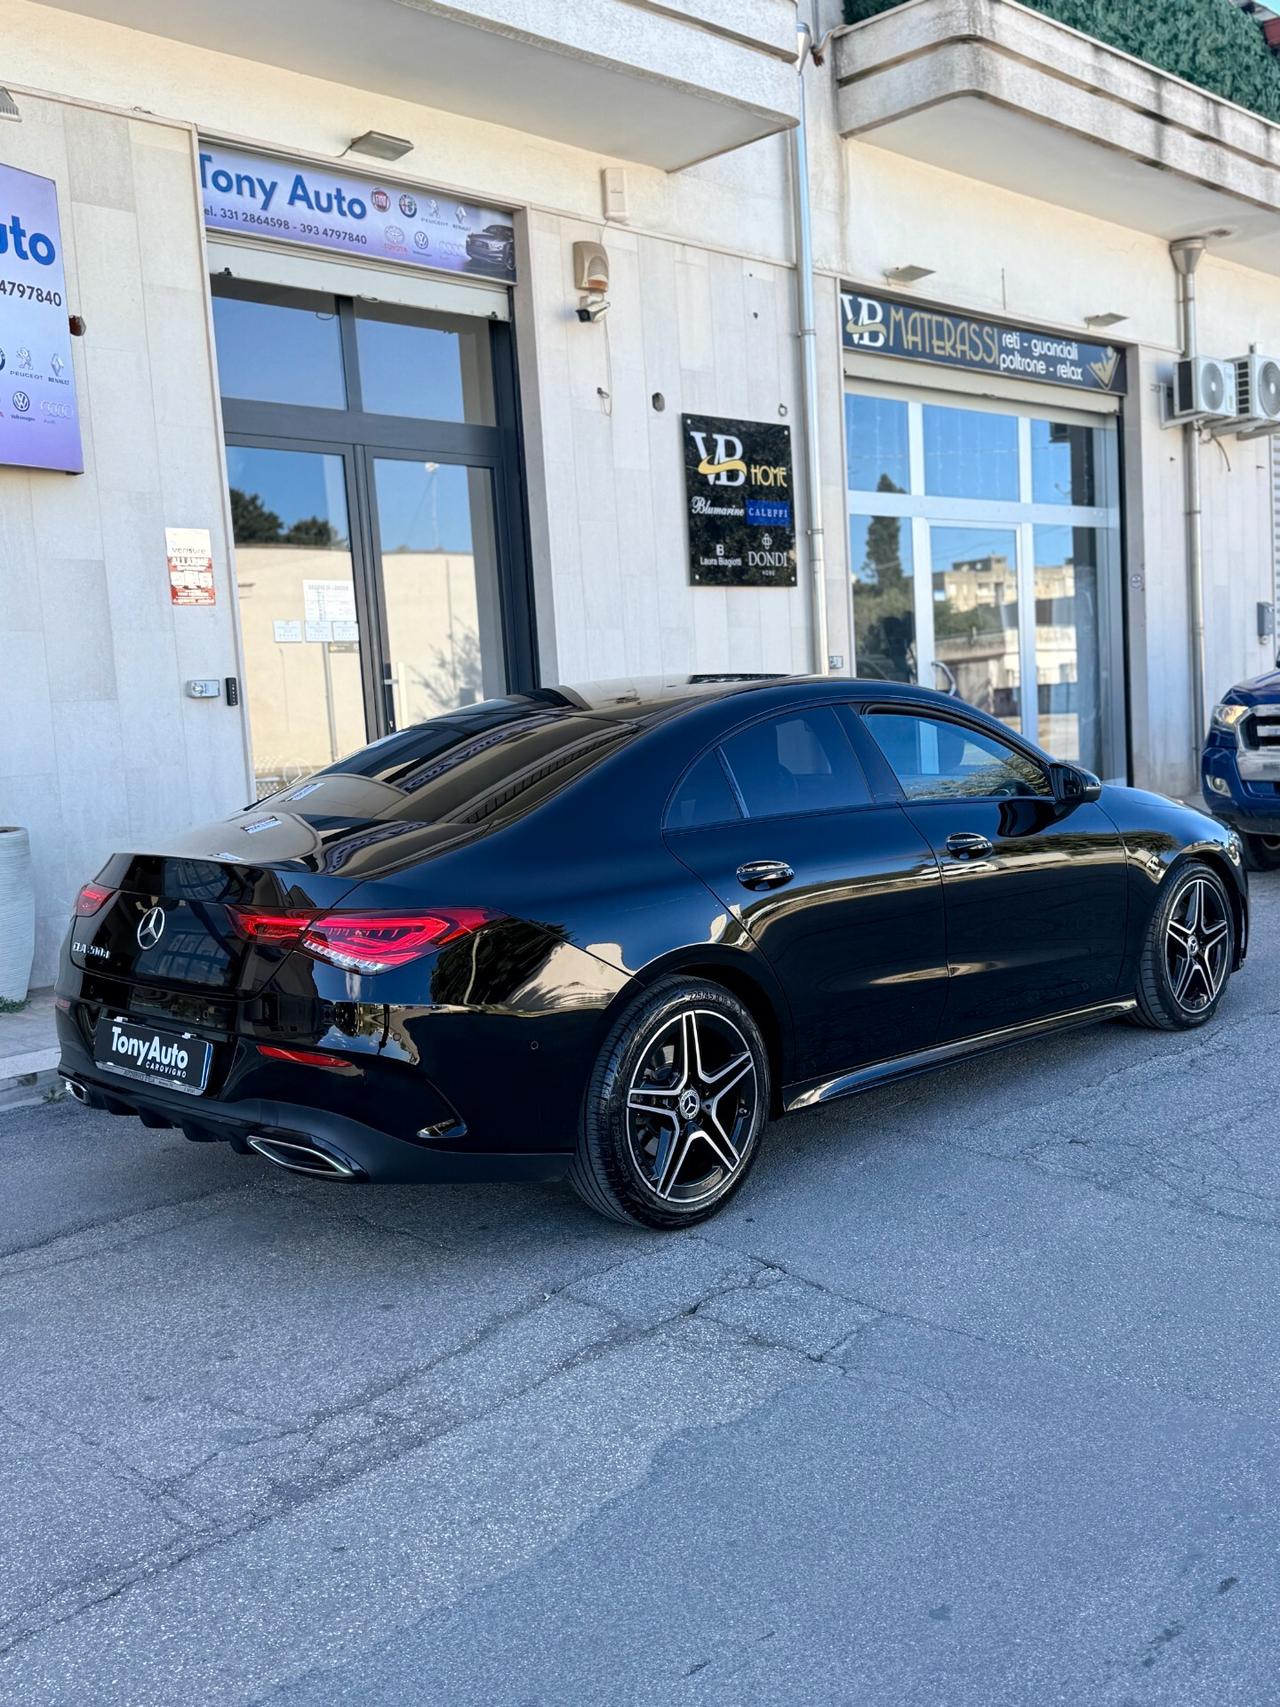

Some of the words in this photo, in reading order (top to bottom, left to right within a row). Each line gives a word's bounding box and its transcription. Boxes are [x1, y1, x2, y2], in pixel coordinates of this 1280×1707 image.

[199, 153, 277, 210] Tony
[287, 174, 367, 220] Auto
[220, 208, 238, 221] 331
[242, 212, 290, 230] 2864598
[300, 223, 320, 236] 393
[322, 227, 367, 245] 4797840
[0, 279, 62, 307] 4797840
[889, 306, 999, 365] MATERASSI
[1002, 332, 1020, 349] reti
[1031, 339, 1079, 360] guanciali
[1000, 351, 1047, 374] poltrone
[1057, 360, 1083, 380] relax
[690, 431, 747, 486] VB
[751, 464, 788, 488] HOME
[691, 496, 745, 516] Blumarine
[748, 507, 788, 518] CALEFFI
[701, 557, 718, 566] Laura
[748, 551, 788, 567] DONDI
[145, 1061, 187, 1078] CAROVIGNO
